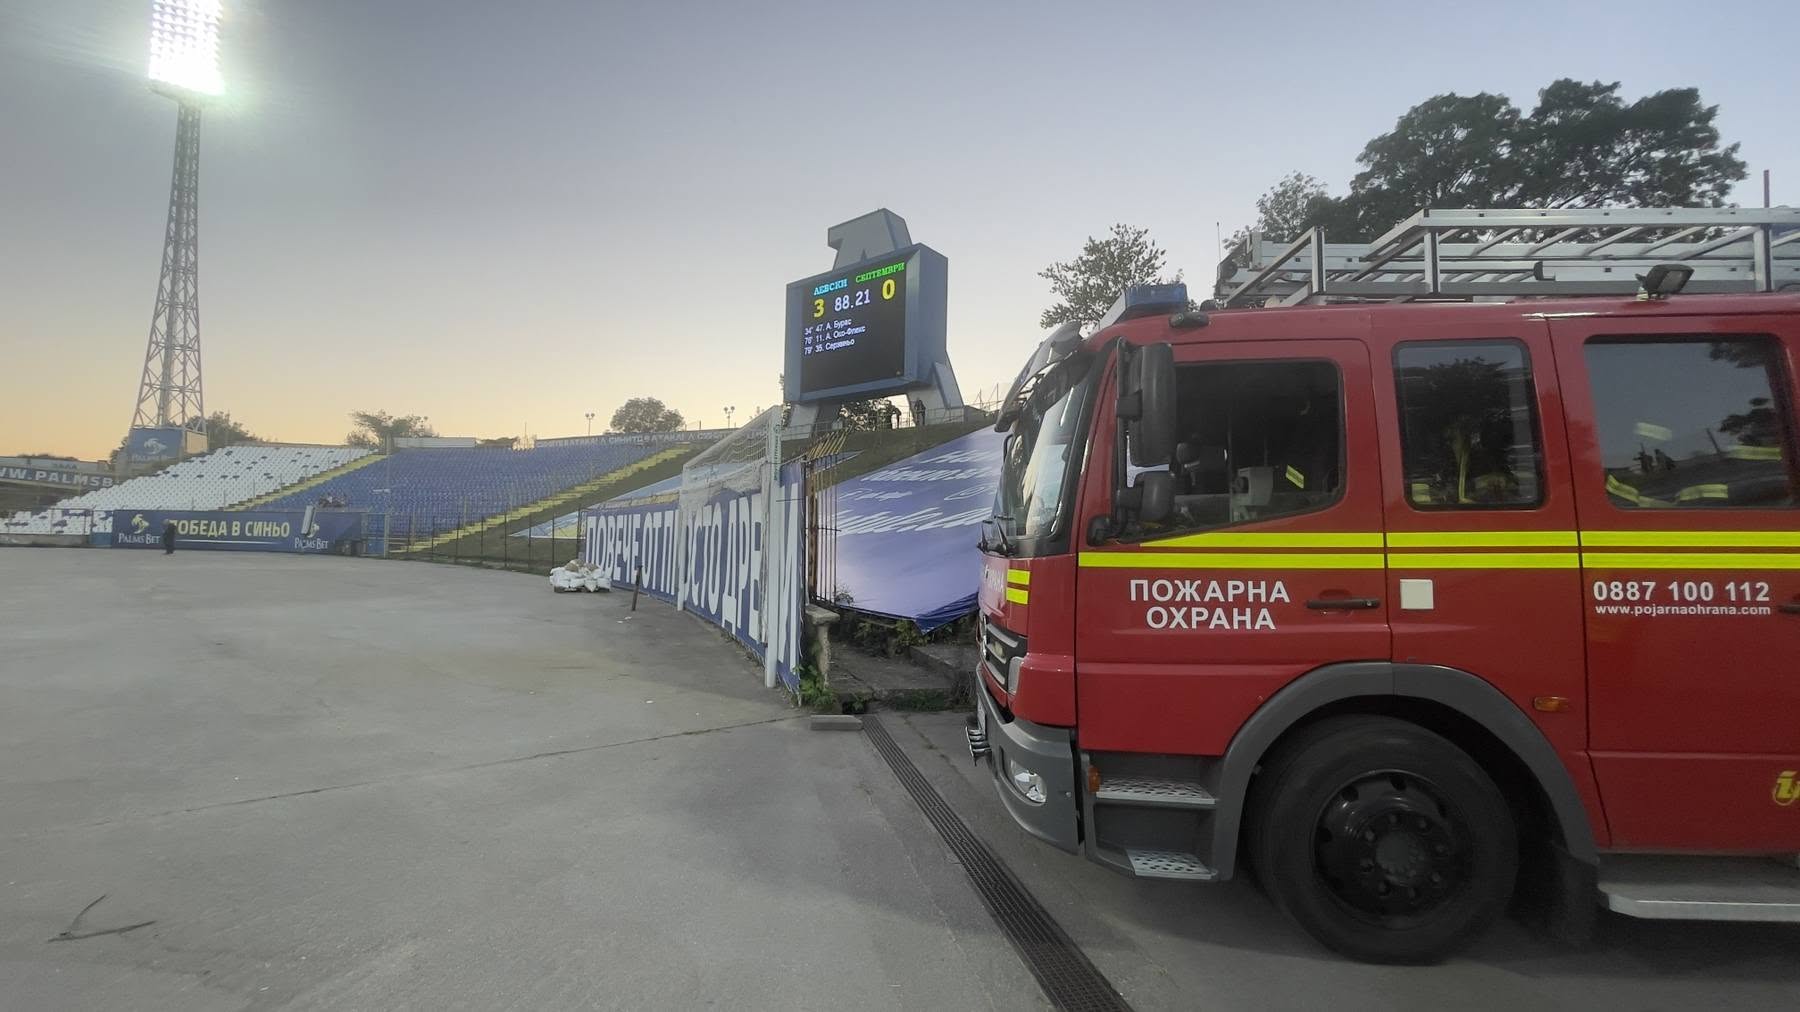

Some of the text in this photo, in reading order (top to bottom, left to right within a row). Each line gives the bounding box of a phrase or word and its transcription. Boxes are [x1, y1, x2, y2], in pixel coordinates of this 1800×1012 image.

[814, 262, 905, 296] ЛЕВСКИ СЕПТЕМВРИ
[813, 298, 825, 318] 3
[882, 279, 896, 300] 0
[231, 520, 241, 537] В
[245, 521, 290, 538] СИНЬО
[585, 513, 641, 581] ПОВЕЧЕ
[641, 511, 662, 590] ОТ
[1130, 579, 1291, 603] ПОЖАРНА
[1593, 581, 1770, 602] 0887 100 112
[1146, 606, 1276, 630] ОХРАНА
[1595, 604, 1771, 617] www.pojarnaohrana.com
